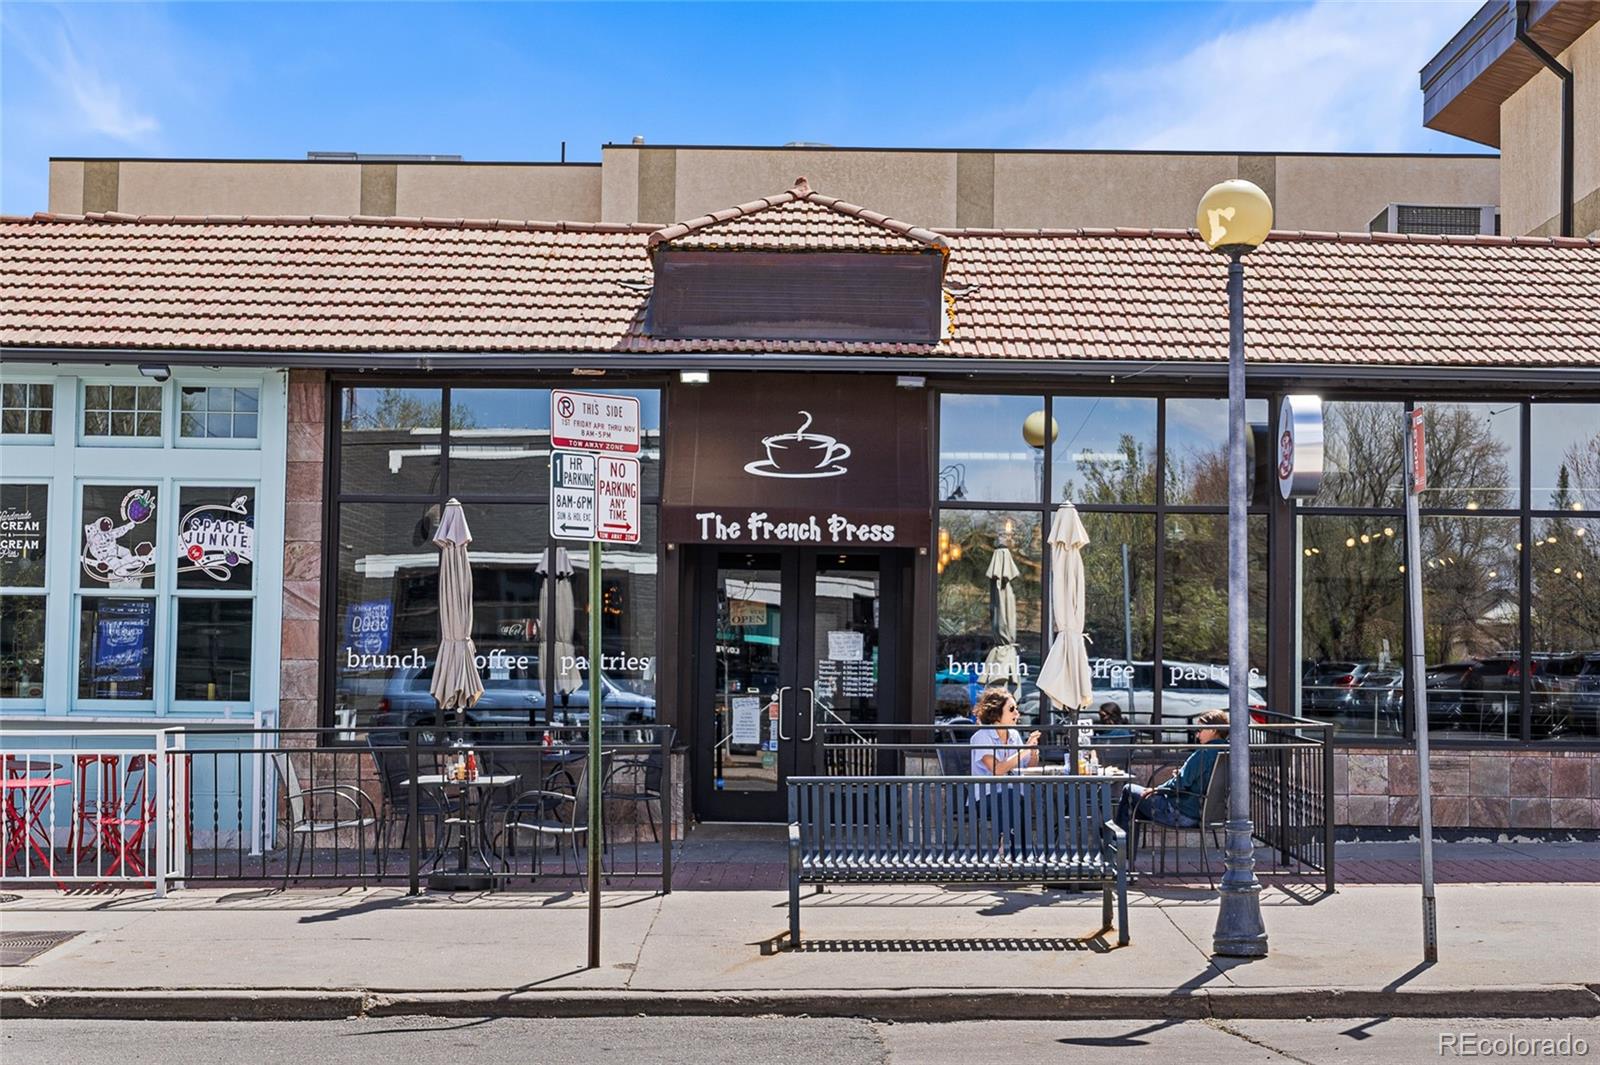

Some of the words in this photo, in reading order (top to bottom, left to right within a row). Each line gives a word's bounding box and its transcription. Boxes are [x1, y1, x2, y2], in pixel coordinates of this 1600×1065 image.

[582, 402, 600, 416] THIS
[605, 404, 624, 418] SIDE
[561, 418, 571, 426] 1ST
[573, 419, 592, 428] FRIDAY
[593, 422, 605, 430] APR
[607, 424, 623, 432] THRU
[624, 425, 636, 433] NOV
[584, 441, 604, 449] AWAY
[605, 443, 625, 451] ZONE
[555, 459, 561, 482] 1
[569, 457, 583, 471] HR
[610, 462, 626, 479] NO
[563, 472, 595, 488] PARKING
[599, 480, 636, 498] PARKING
[556, 494, 593, 510] 8AM-6PM
[609, 498, 626, 509] ANY
[557, 511, 566, 520] SUN
[573, 512, 582, 521] HOL
[583, 513, 592, 522] EXC
[609, 509, 628, 521] TIME
[1, 521, 40, 531] CREAM
[190, 517, 246, 535] SPACE
[695, 512, 741, 541] The
[747, 511, 821, 542] French
[826, 513, 896, 543] Press
[0, 540, 39, 549] CREAM
[184, 531, 249, 548] JUNKIE
[731, 615, 765, 624] OPEN
[345, 647, 428, 670] brunch
[474, 648, 529, 670] offee
[560, 650, 650, 676] patries
[946, 654, 1030, 676] brunch
[1087, 658, 1135, 679] ffee
[1168, 664, 1260, 687] pastrs
